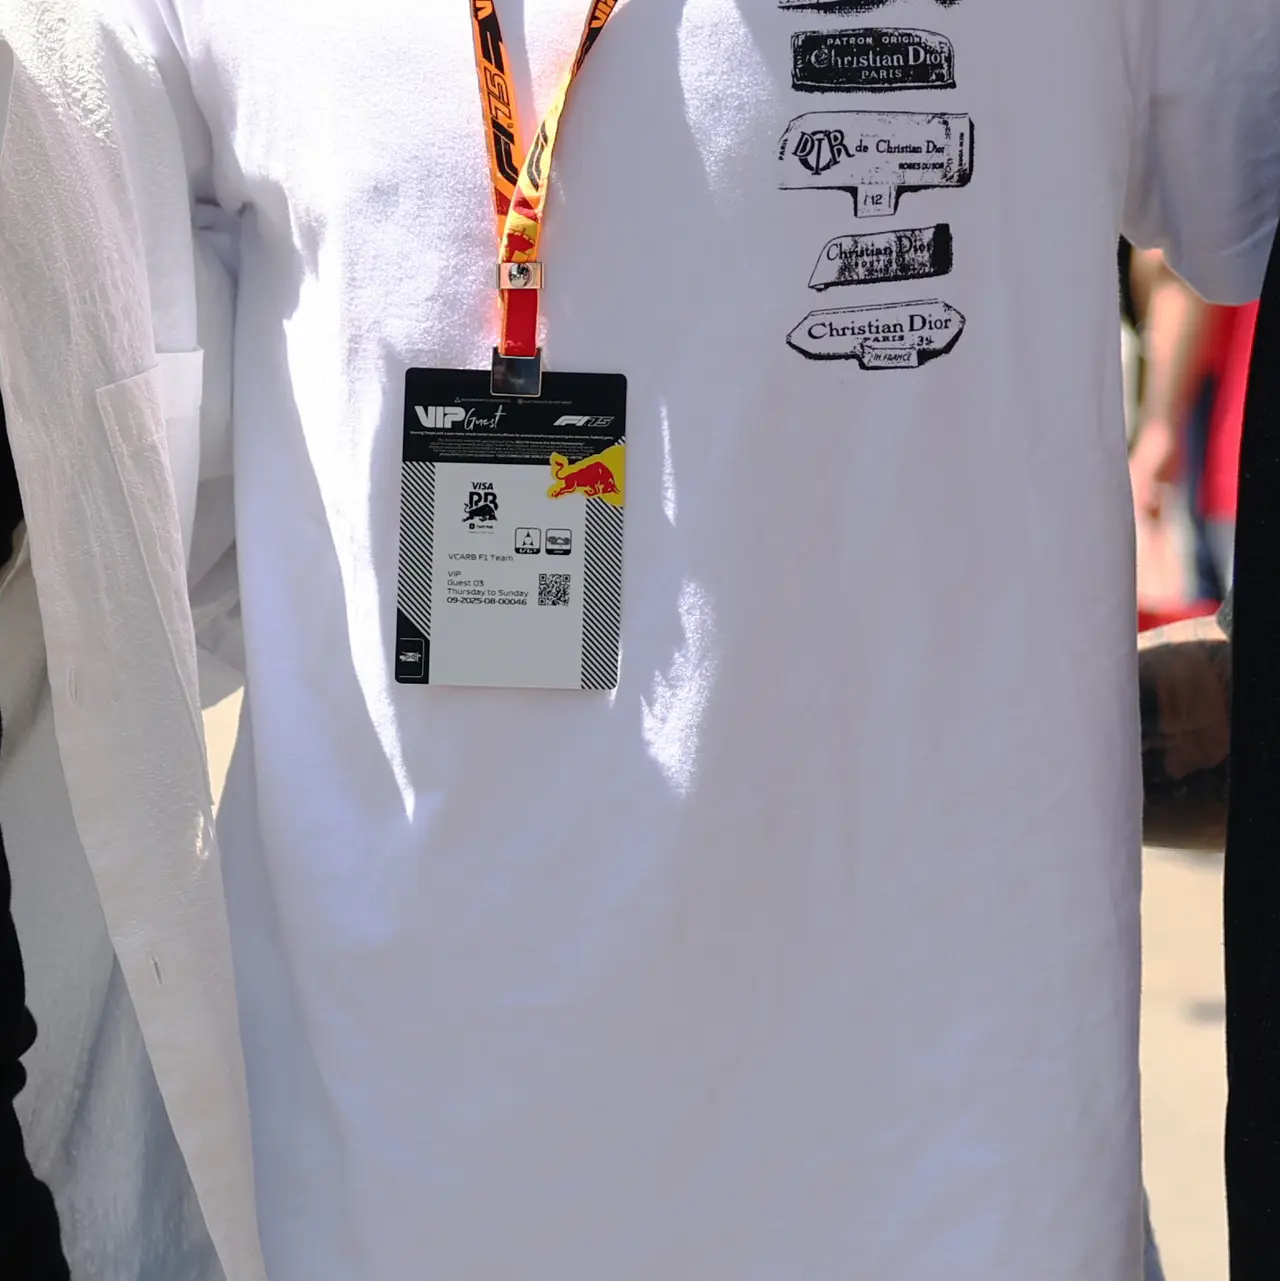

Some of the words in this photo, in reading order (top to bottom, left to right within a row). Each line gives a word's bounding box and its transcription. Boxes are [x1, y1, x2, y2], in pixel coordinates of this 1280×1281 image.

[826, 36, 873, 45] PATRON
[810, 47, 905, 68] Christian
[908, 45, 949, 66] Dior
[861, 69, 903, 80] PARIS
[855, 138, 869, 153] de
[876, 139, 923, 154] Christian
[925, 139, 946, 154] Dior
[826, 241, 893, 261] Christian
[807, 319, 904, 339] Christian
[908, 313, 952, 332] Dior
[863, 334, 905, 343] PARIS
[883, 352, 913, 362] FRANCE
[414, 406, 466, 429] VIP
[464, 404, 508, 431] Guest
[472, 482, 494, 490] VISA
[448, 553, 477, 561] VCARB
[490, 554, 514, 562] Team
[447, 579, 472, 587] Guest
[447, 588, 486, 596] Thursday
[498, 589, 529, 597] Sunday
